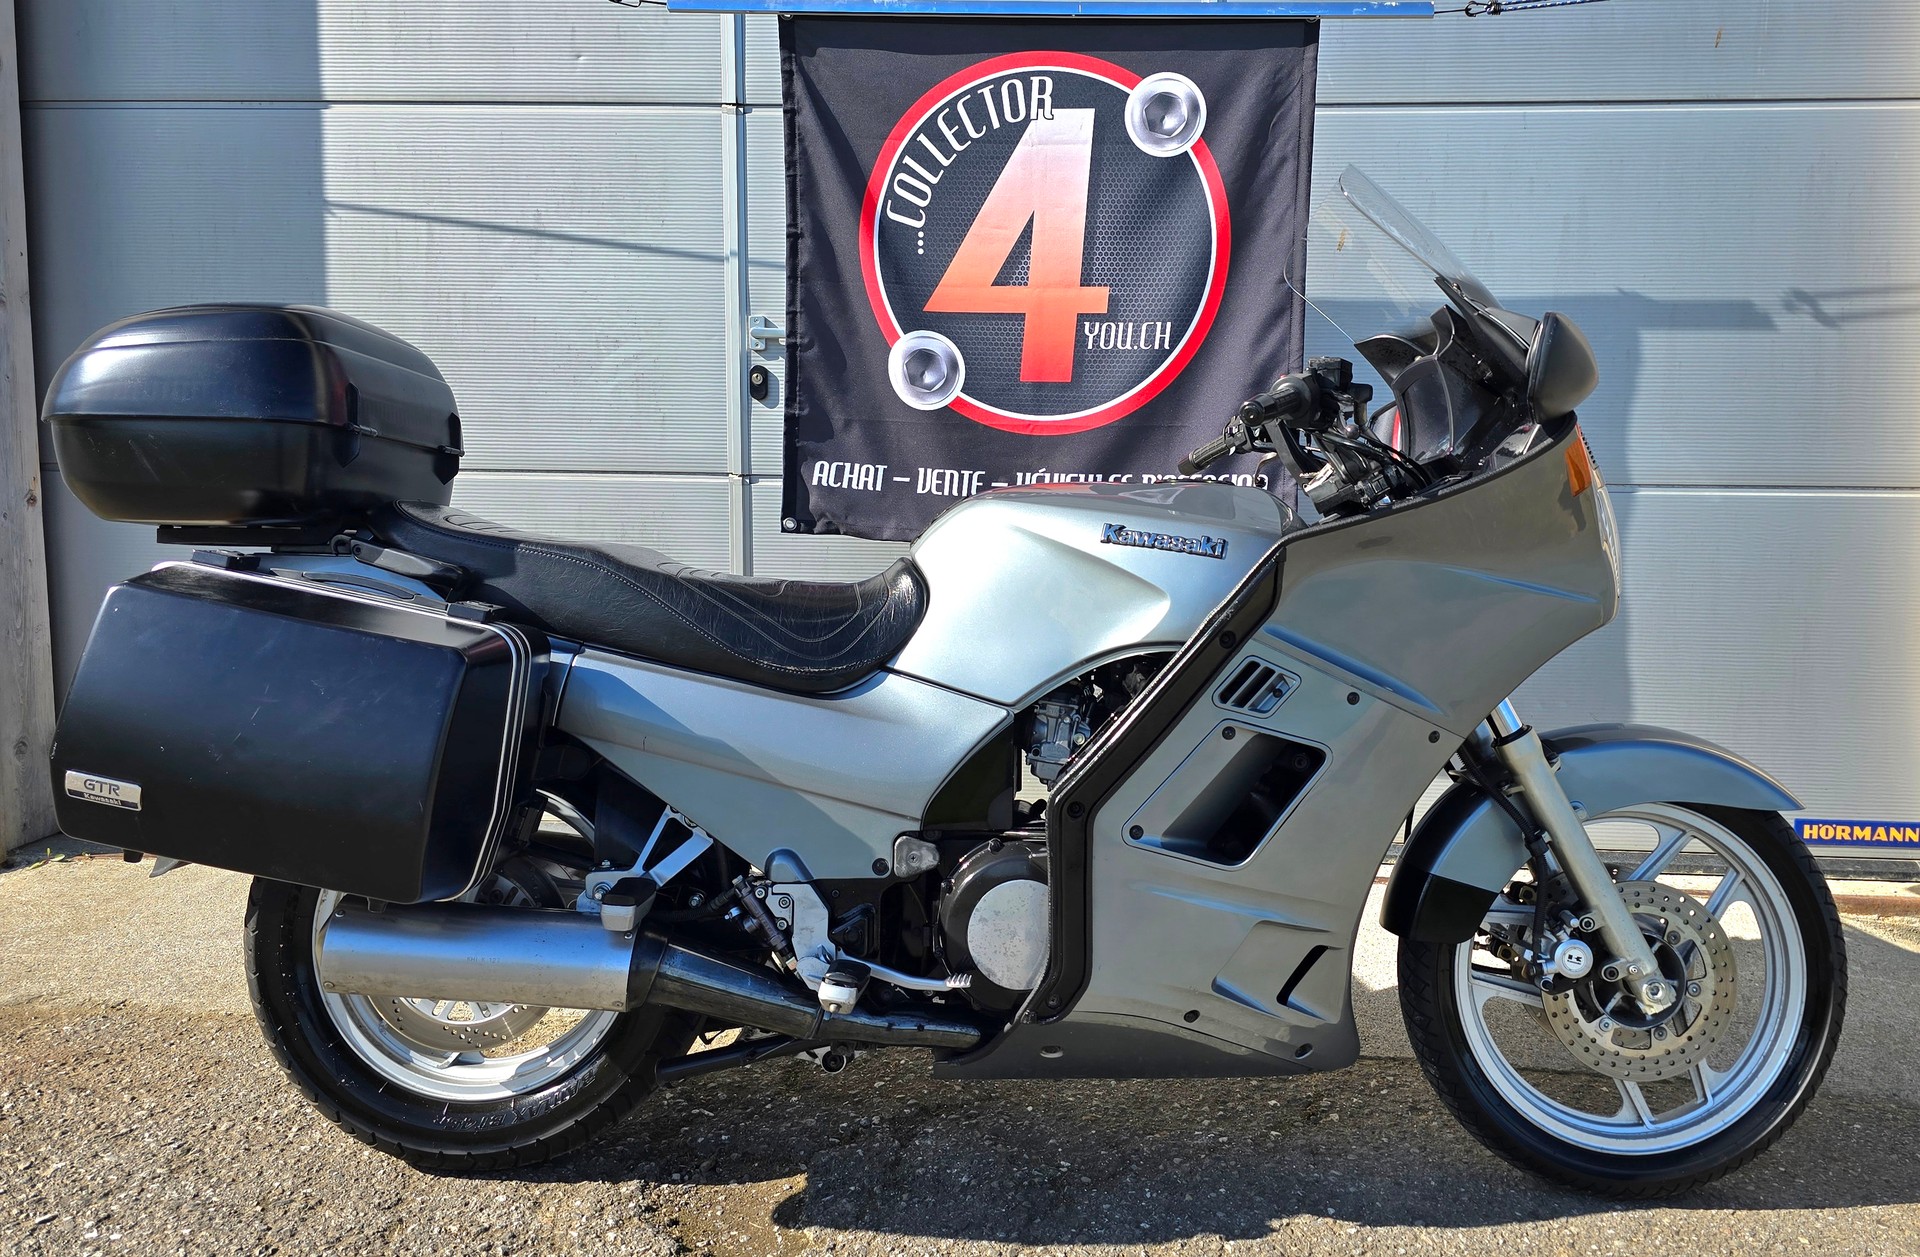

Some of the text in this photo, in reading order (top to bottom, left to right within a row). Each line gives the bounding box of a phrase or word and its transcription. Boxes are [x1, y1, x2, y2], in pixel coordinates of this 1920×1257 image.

[922, 107, 1110, 383] 4
[1083, 321, 1172, 351] YOU.CH
[811, 460, 888, 492] ACHAT
[916, 467, 986, 497] VENTE
[1101, 522, 1228, 560] Kawasaki
[83, 778, 121, 797] GTR
[83, 792, 122, 806] Kawasaki
[1802, 823, 1920, 843] HÖRMANN
